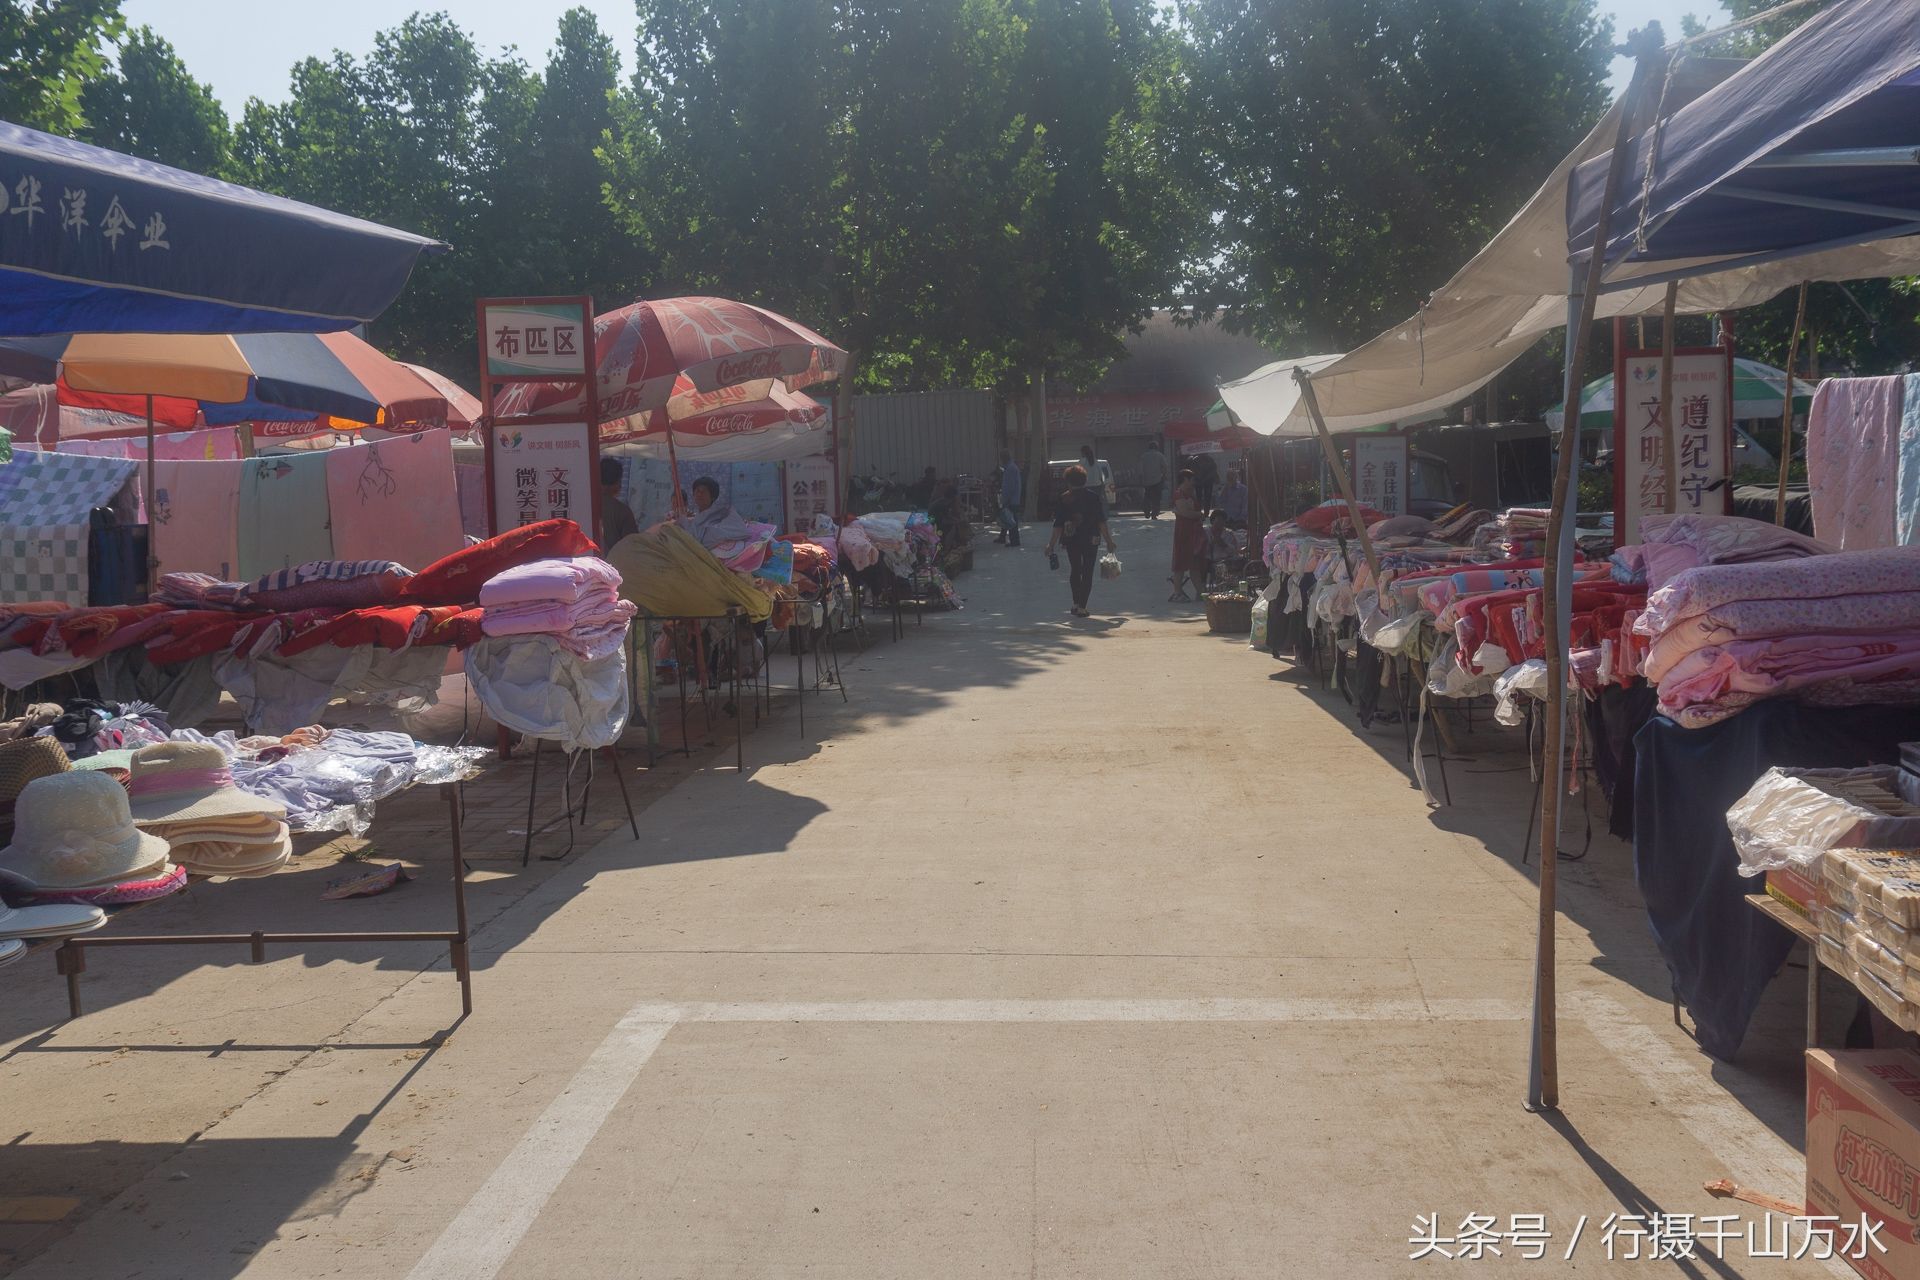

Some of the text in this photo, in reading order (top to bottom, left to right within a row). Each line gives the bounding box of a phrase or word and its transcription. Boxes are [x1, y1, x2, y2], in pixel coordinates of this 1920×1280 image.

[10, 173, 170, 254] 华洋伞业
[495, 326, 577, 358] 布匹区
[1050, 407, 1210, 428] 华海世纪
[1680, 394, 1710, 514] 遵纪守
